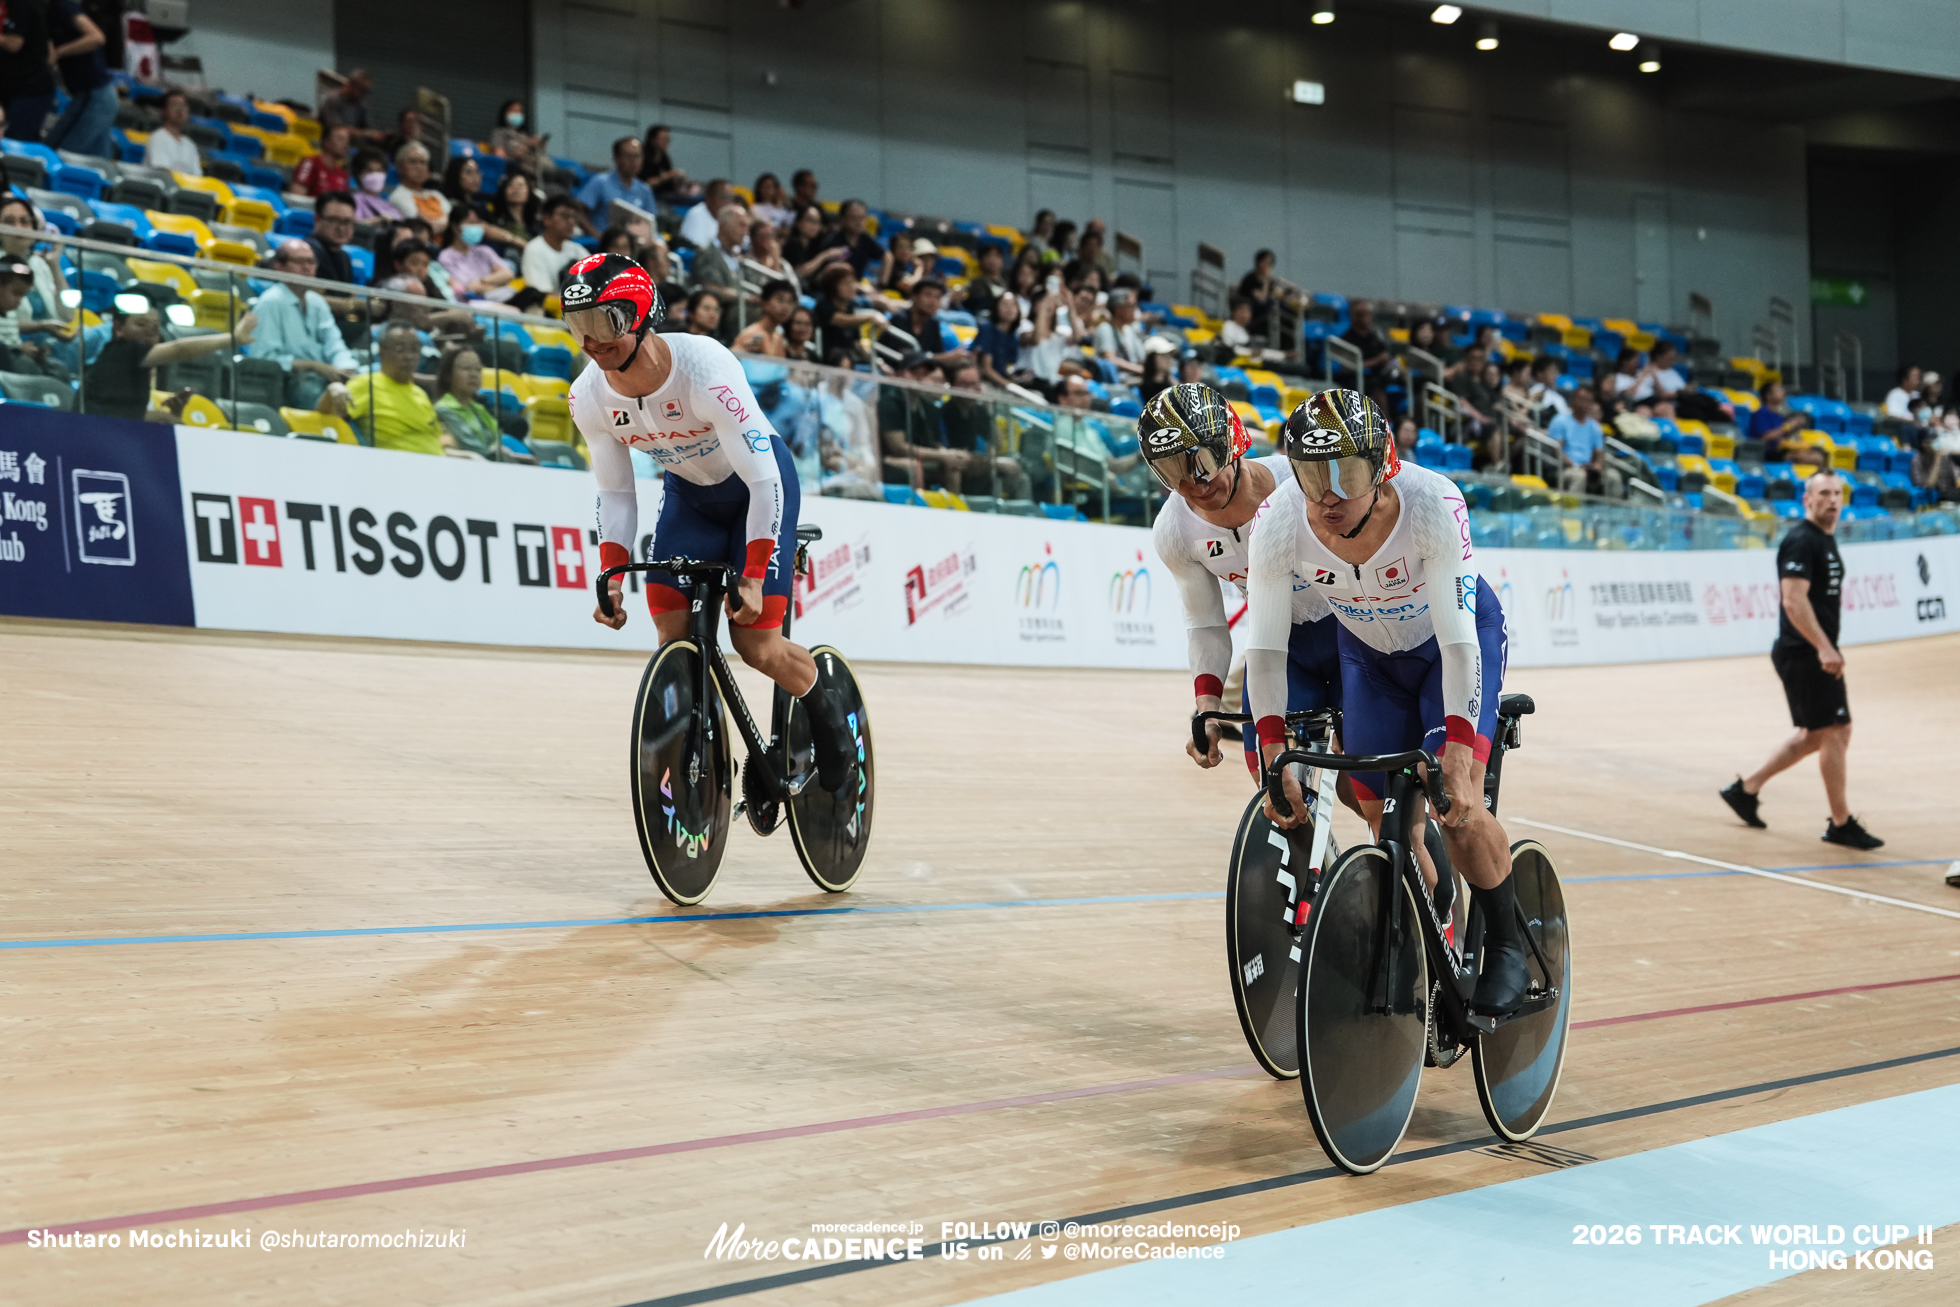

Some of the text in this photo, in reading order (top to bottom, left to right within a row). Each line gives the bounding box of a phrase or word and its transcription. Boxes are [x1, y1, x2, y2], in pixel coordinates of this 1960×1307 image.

[564, 297, 592, 306] Kabuto
[1151, 441, 1184, 453] Kabuto
[1302, 445, 1342, 455] Kabuto
[0, 450, 46, 485] 馬會
[2, 491, 48, 531] Kong
[285, 501, 499, 584] TISSOT
[1455, 576, 1464, 610] KEIRIN
[1409, 846, 1462, 980] BRIDGESTONE
